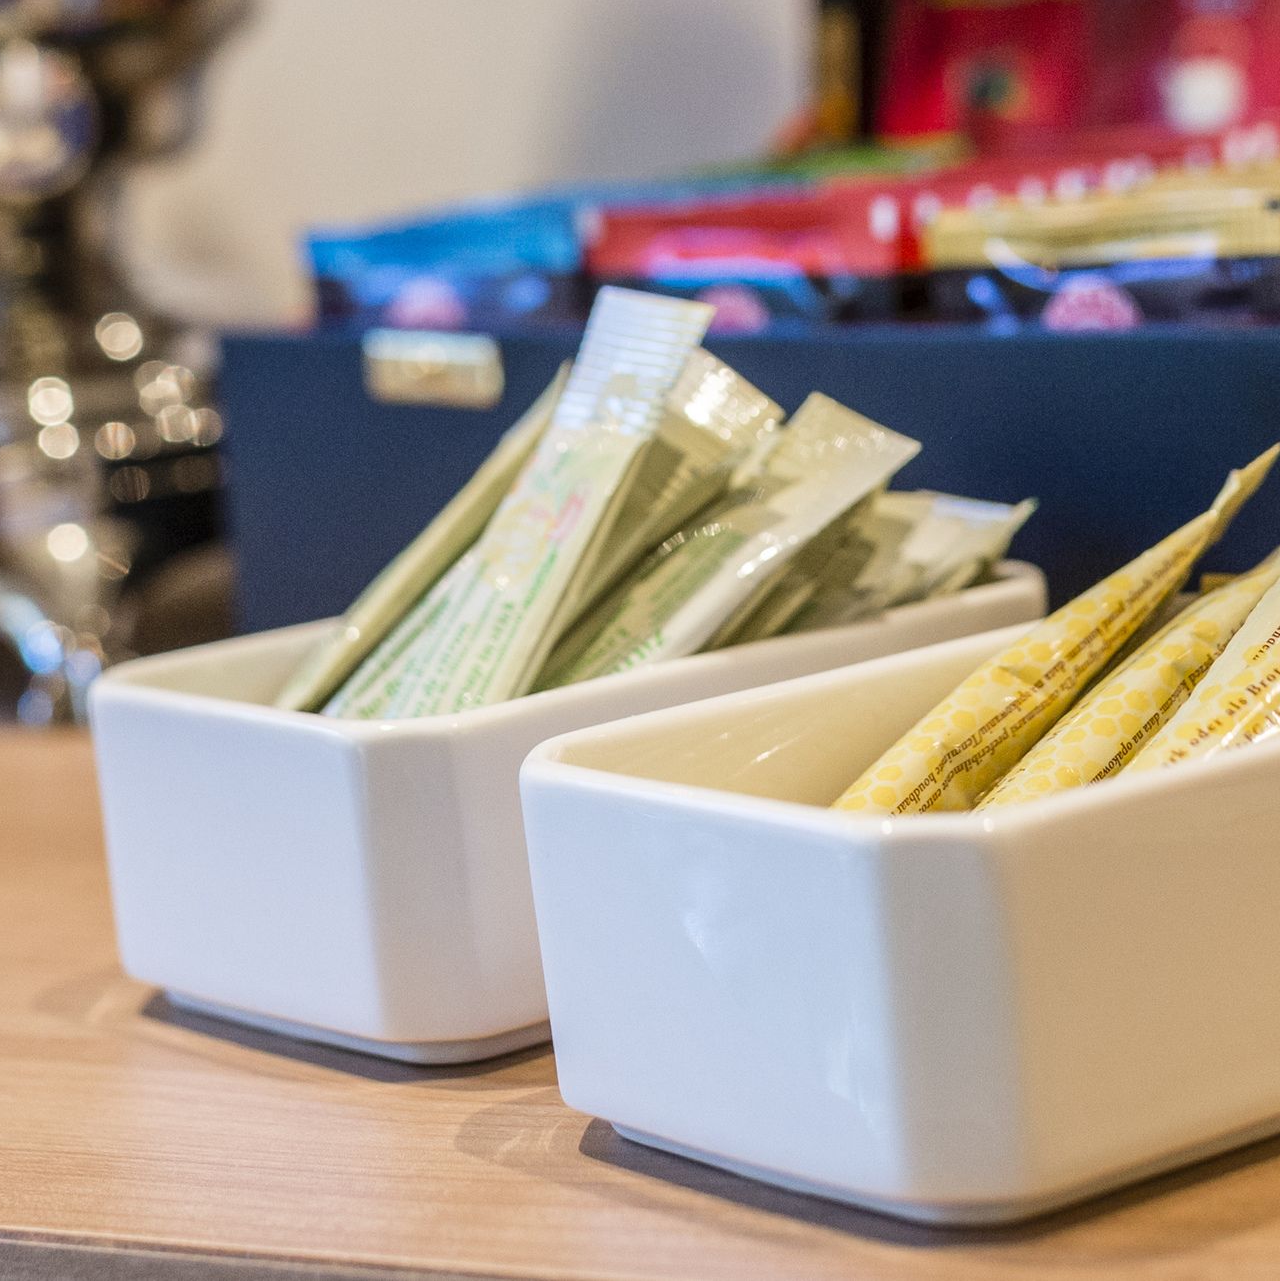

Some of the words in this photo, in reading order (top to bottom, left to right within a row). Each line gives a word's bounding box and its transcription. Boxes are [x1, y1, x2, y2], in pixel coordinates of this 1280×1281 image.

[1225, 697, 1248, 716] als
[1142, 712, 1162, 732] data
[1131, 729, 1145, 744] na
[895, 771, 938, 814] houdbaar
[917, 787, 942, 815] entro:
